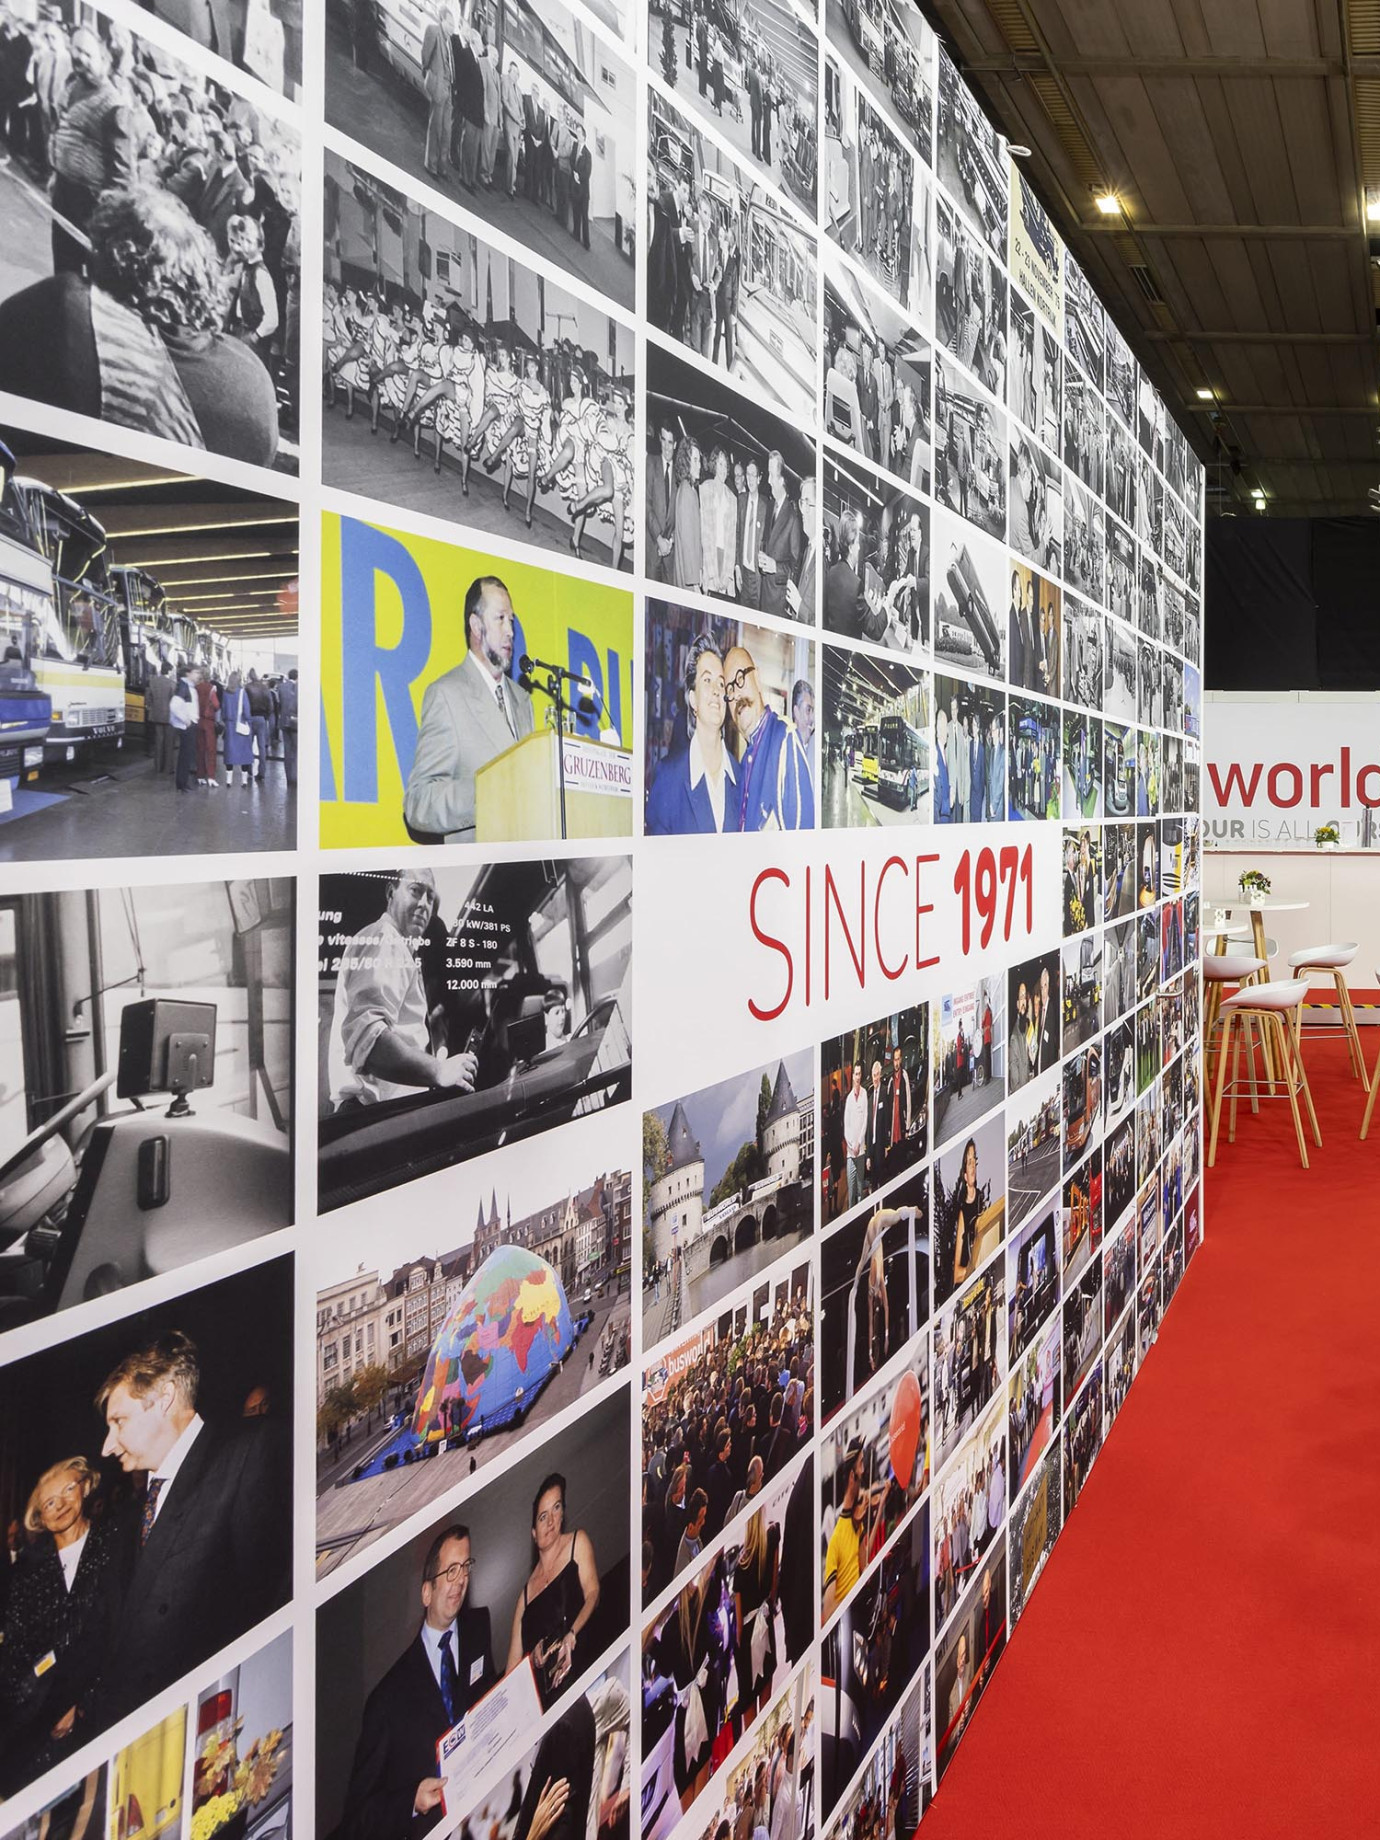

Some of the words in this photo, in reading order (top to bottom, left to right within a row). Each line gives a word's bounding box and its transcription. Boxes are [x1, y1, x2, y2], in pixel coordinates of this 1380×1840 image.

[564, 754, 631, 785] GRUZENBERG
[1252, 819, 1271, 838] IS
[1278, 819, 1315, 839] ALL
[483, 904, 494, 913] LA
[466, 920, 498, 931] kW/381
[501, 924, 511, 932] PS
[748, 854, 940, 1021] SINCE
[954, 843, 1032, 956] 1971
[328, 933, 431, 947] vitesses/triebe
[446, 937, 458, 947] ZF
[460, 938, 466, 947] 8
[468, 939, 475, 948] S
[482, 940, 497, 949] 180
[446, 958, 473, 968] 3.590
[446, 979, 479, 990] 12.000
